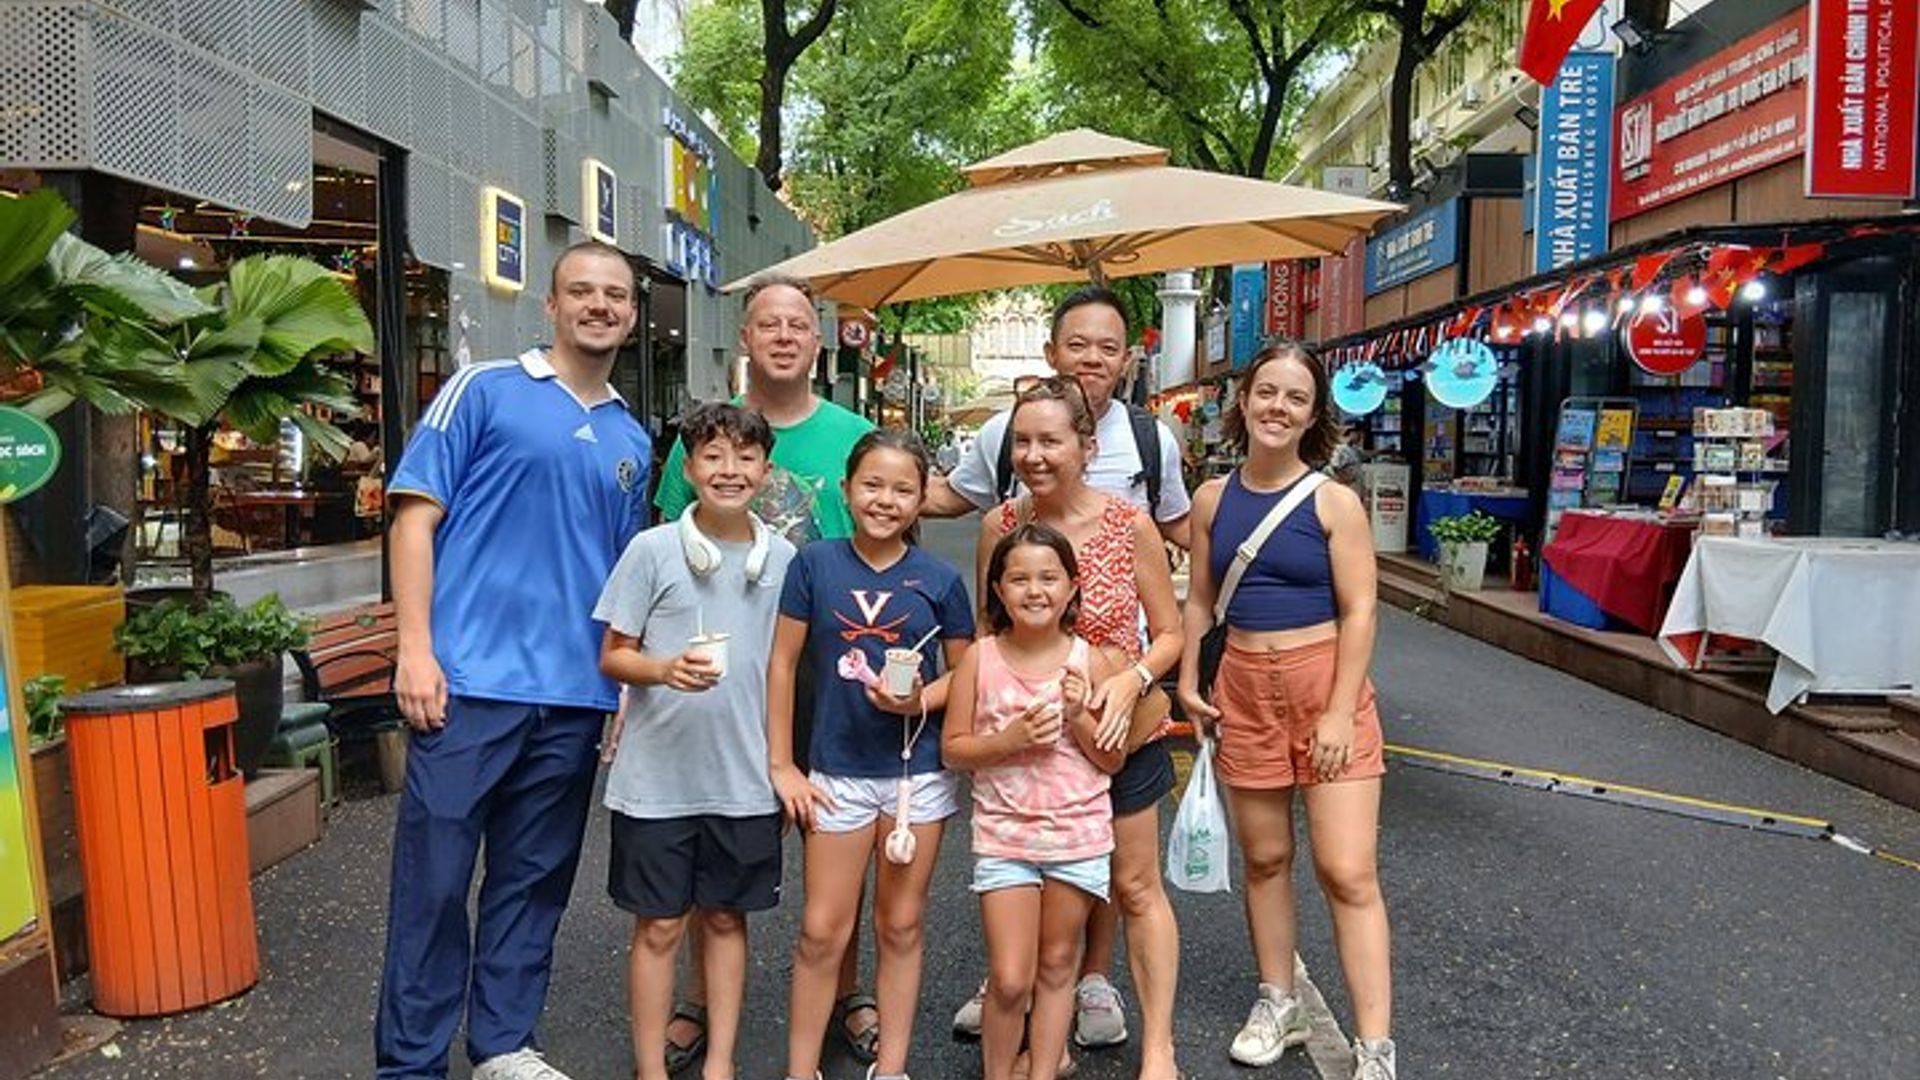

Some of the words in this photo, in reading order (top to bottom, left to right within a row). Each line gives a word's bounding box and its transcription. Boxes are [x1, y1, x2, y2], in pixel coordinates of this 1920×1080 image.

[1875, 10, 1893, 88] POLITICAL
[1585, 64, 1599, 118] HOUSE
[1838, 62, 1866, 93] BẢN
[1550, 114, 1581, 160] BẢN
[1837, 97, 1864, 135] XUẤT
[1873, 93, 1890, 170] NATIONAL
[1581, 128, 1598, 229] PUBLISHING
[1839, 138, 1862, 169] NHÀ
[1548, 167, 1578, 219] XUẤT
[1271, 264, 1289, 317] ĐÔNG
[851, 590, 893, 626] V
